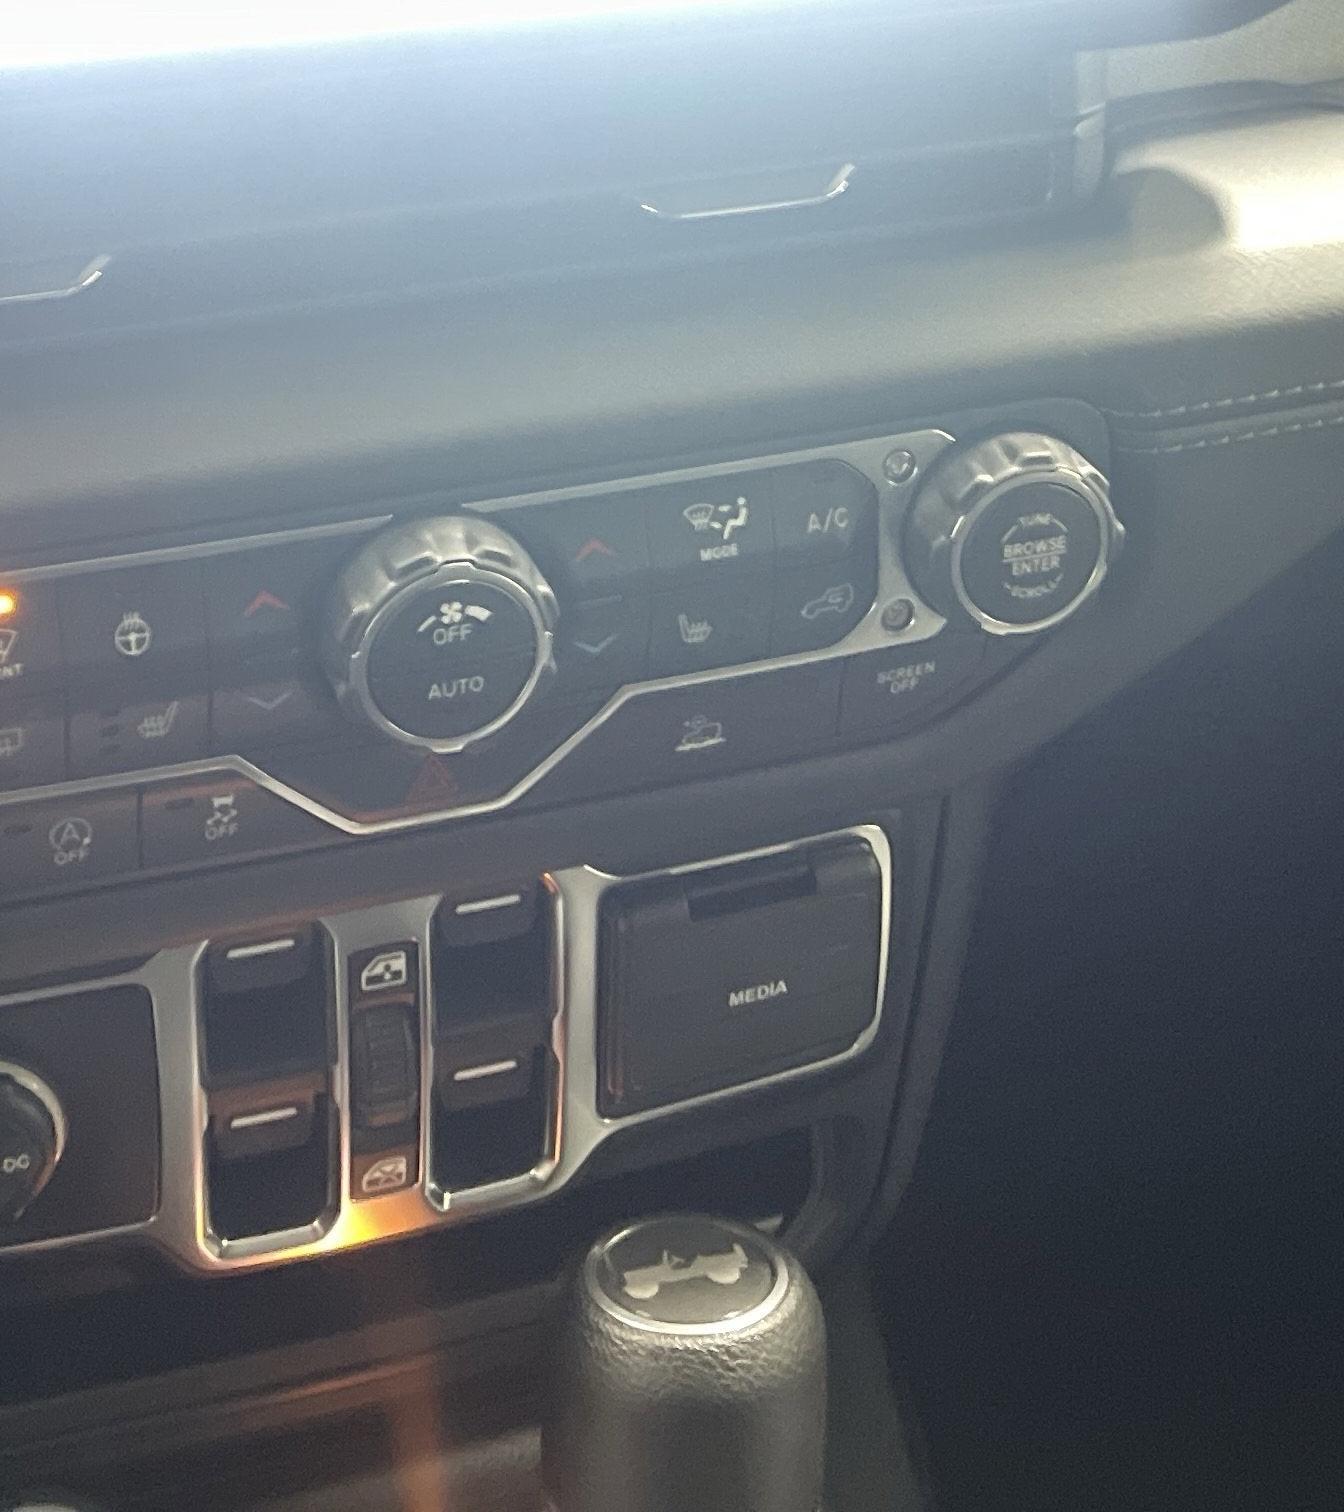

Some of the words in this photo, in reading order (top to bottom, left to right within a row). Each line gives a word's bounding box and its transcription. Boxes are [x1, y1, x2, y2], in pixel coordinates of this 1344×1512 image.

[807, 506, 849, 534] A/C
[699, 543, 739, 561] MODE
[1004, 535, 1067, 558] BROWSE
[1012, 555, 1061, 576] ENTER
[433, 624, 472, 646] OFF
[876, 661, 936, 684] SCREEN
[428, 675, 485, 701] AUTO
[890, 678, 919, 694] OFF
[203, 821, 240, 841] OFF
[53, 847, 89, 867] OFF
[728, 979, 788, 1007] MEDIA
[2, 1154, 30, 1173] DC
